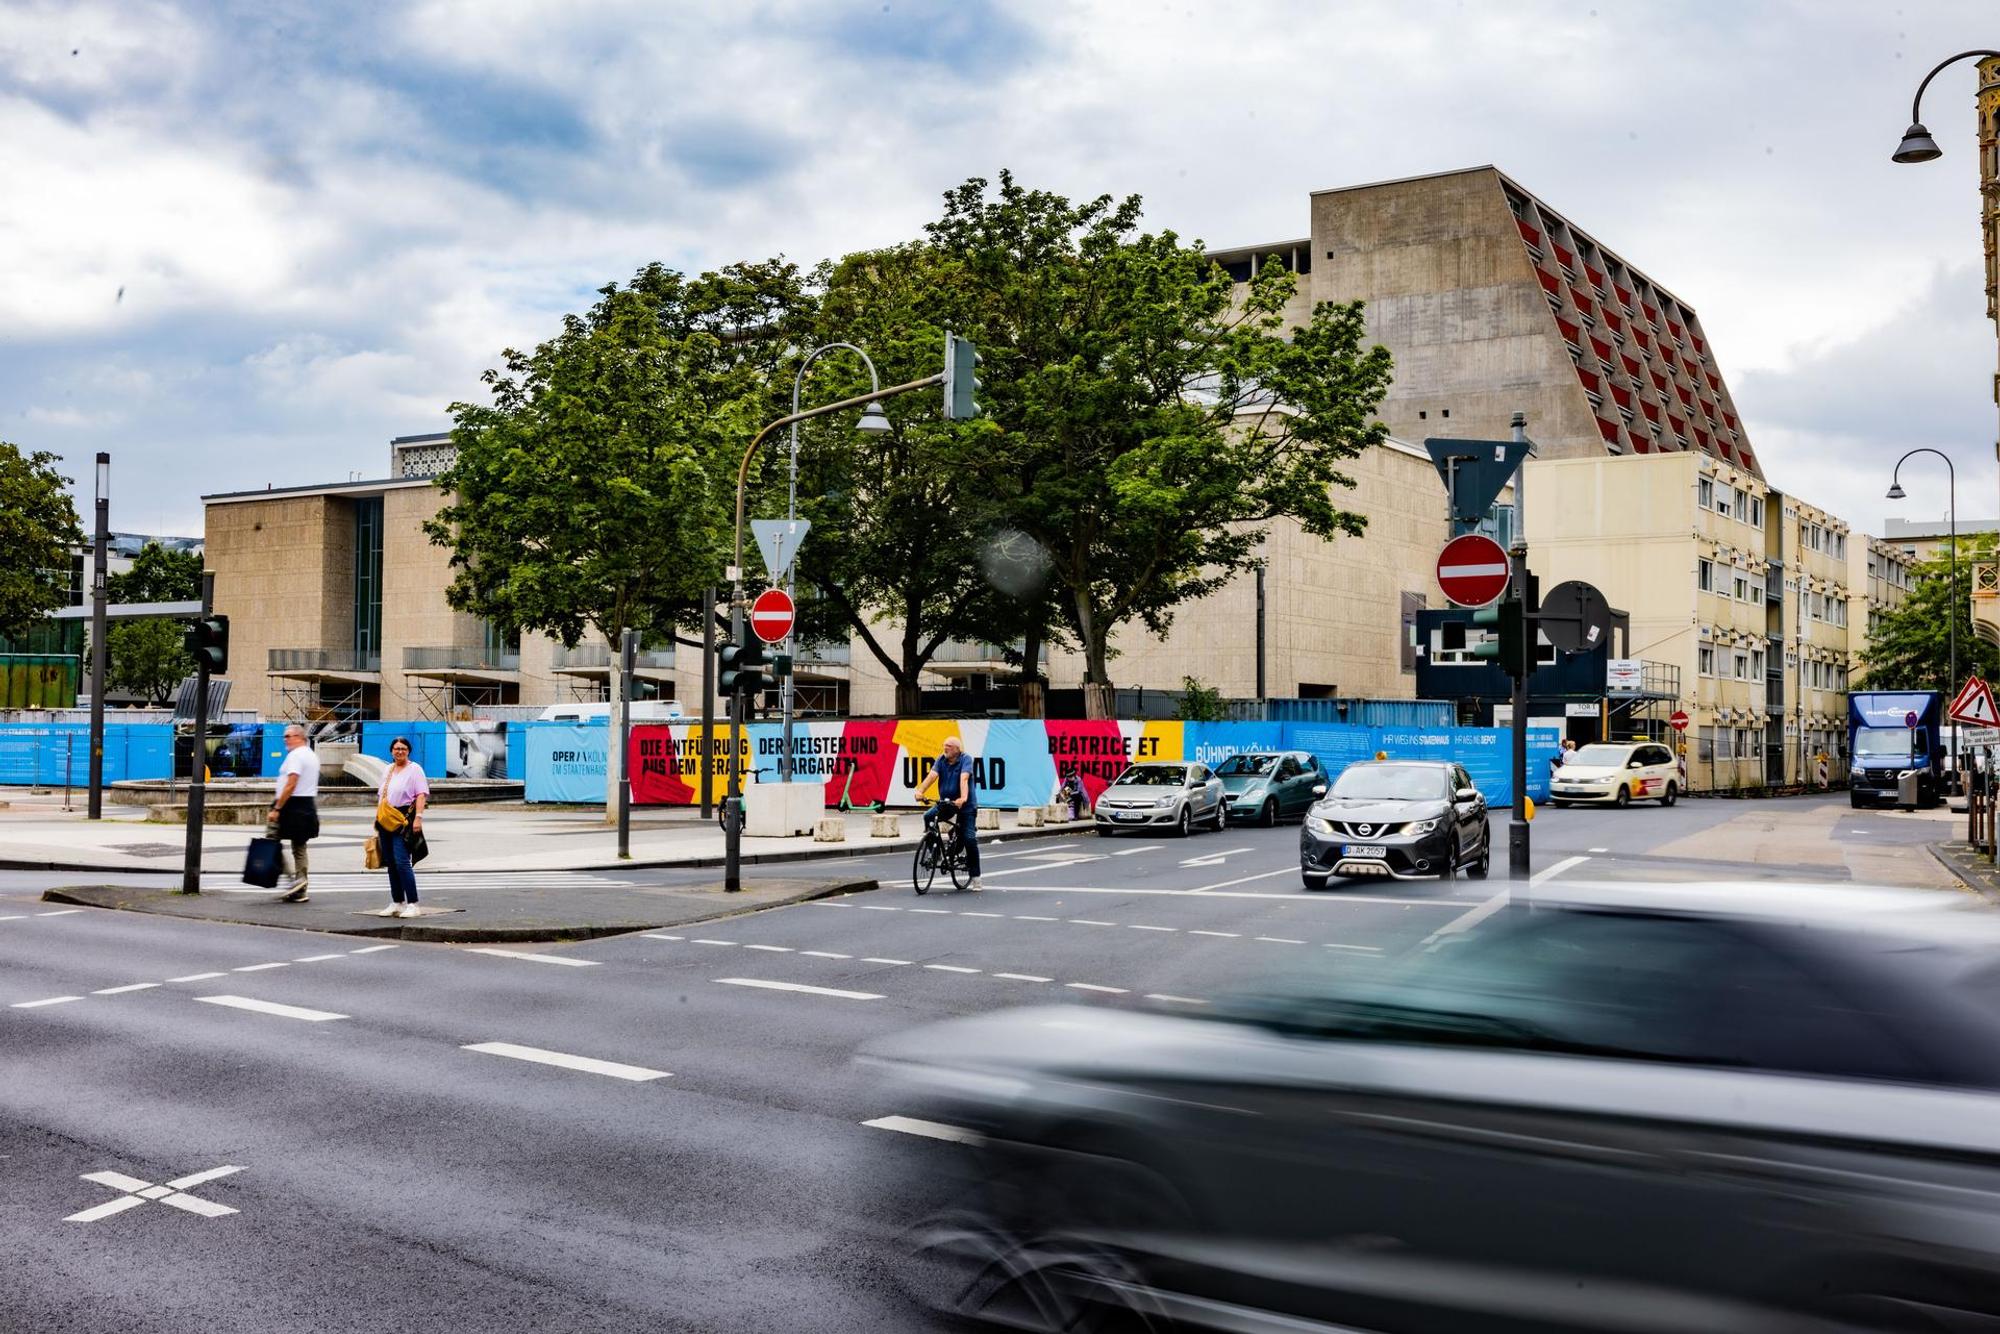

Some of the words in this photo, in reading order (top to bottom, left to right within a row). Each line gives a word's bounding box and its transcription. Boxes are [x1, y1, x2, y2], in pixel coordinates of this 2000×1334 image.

[640, 739, 662, 756] DIE
[666, 736, 748, 756] ENTFÜRUG
[759, 737, 784, 754] DER
[850, 736, 878, 754] UND
[1048, 732, 1132, 756] BÉATRICE
[1138, 737, 1160, 756] ET
[552, 750, 575, 762] OPER
[552, 764, 562, 776] IM
[563, 764, 608, 776] STAATENHAUS
[641, 758, 666, 776] AUS
[670, 758, 696, 775] DEM
[700, 758, 747, 776] ERAL
[903, 757, 1006, 790] UPAD
